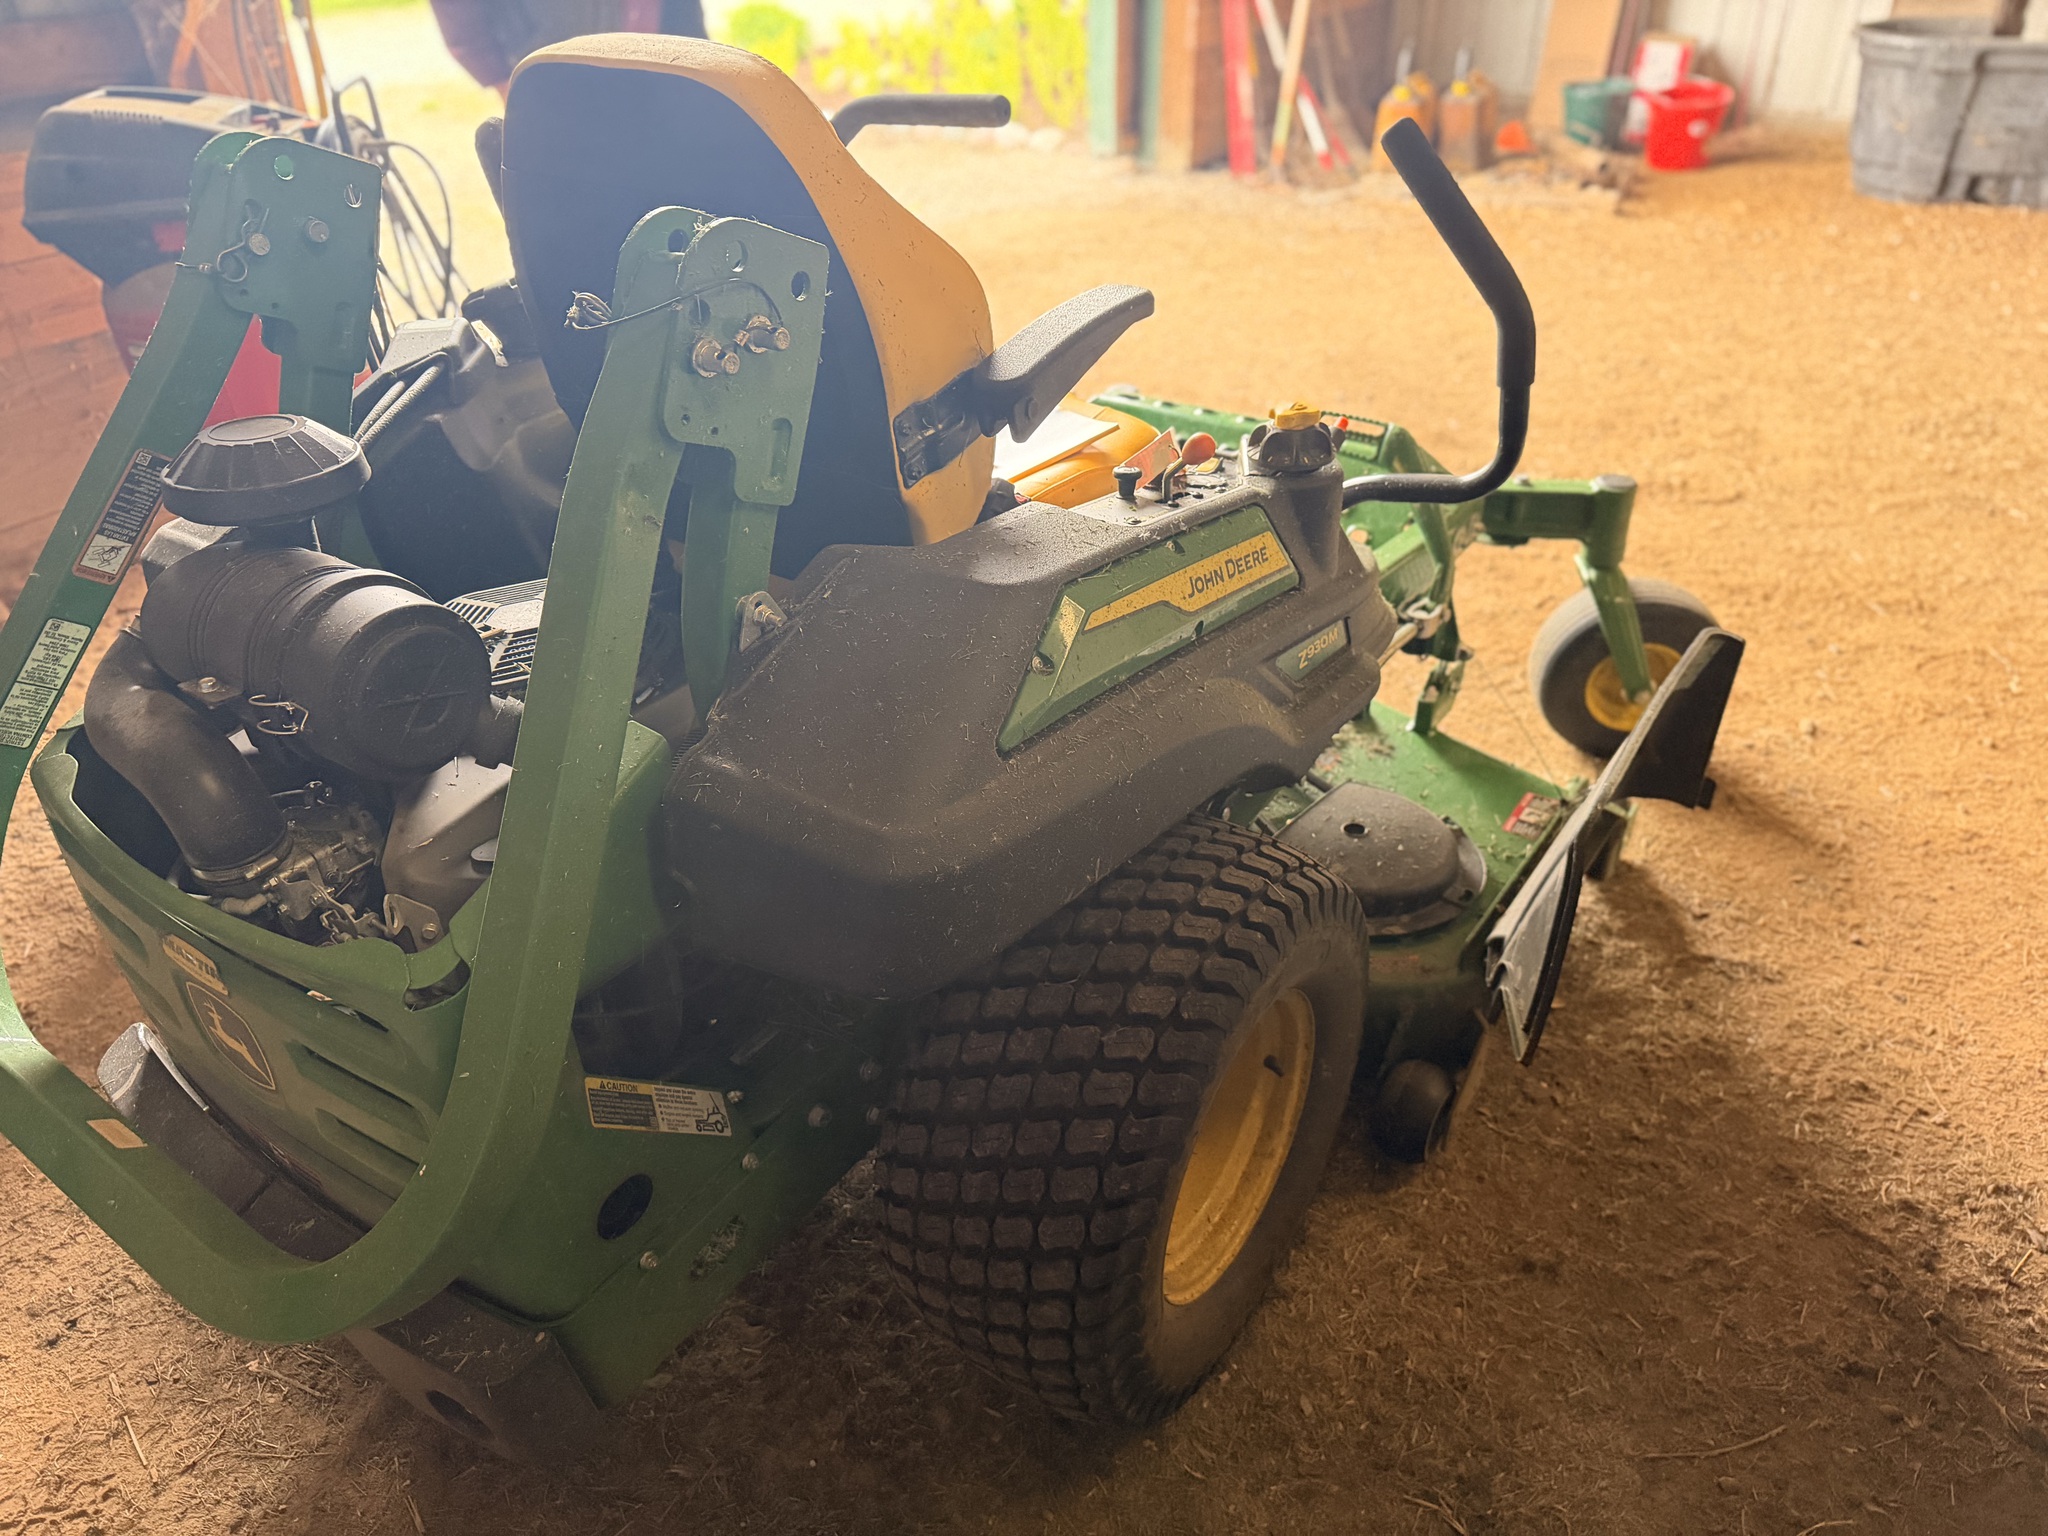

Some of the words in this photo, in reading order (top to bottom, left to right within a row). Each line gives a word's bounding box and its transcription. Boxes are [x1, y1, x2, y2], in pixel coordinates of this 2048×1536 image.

[1188, 566, 1225, 599] JOHN
[1225, 546, 1269, 580] DEERE
[1298, 627, 1339, 670] Z930M
[606, 1082, 639, 1093] CAUTION
